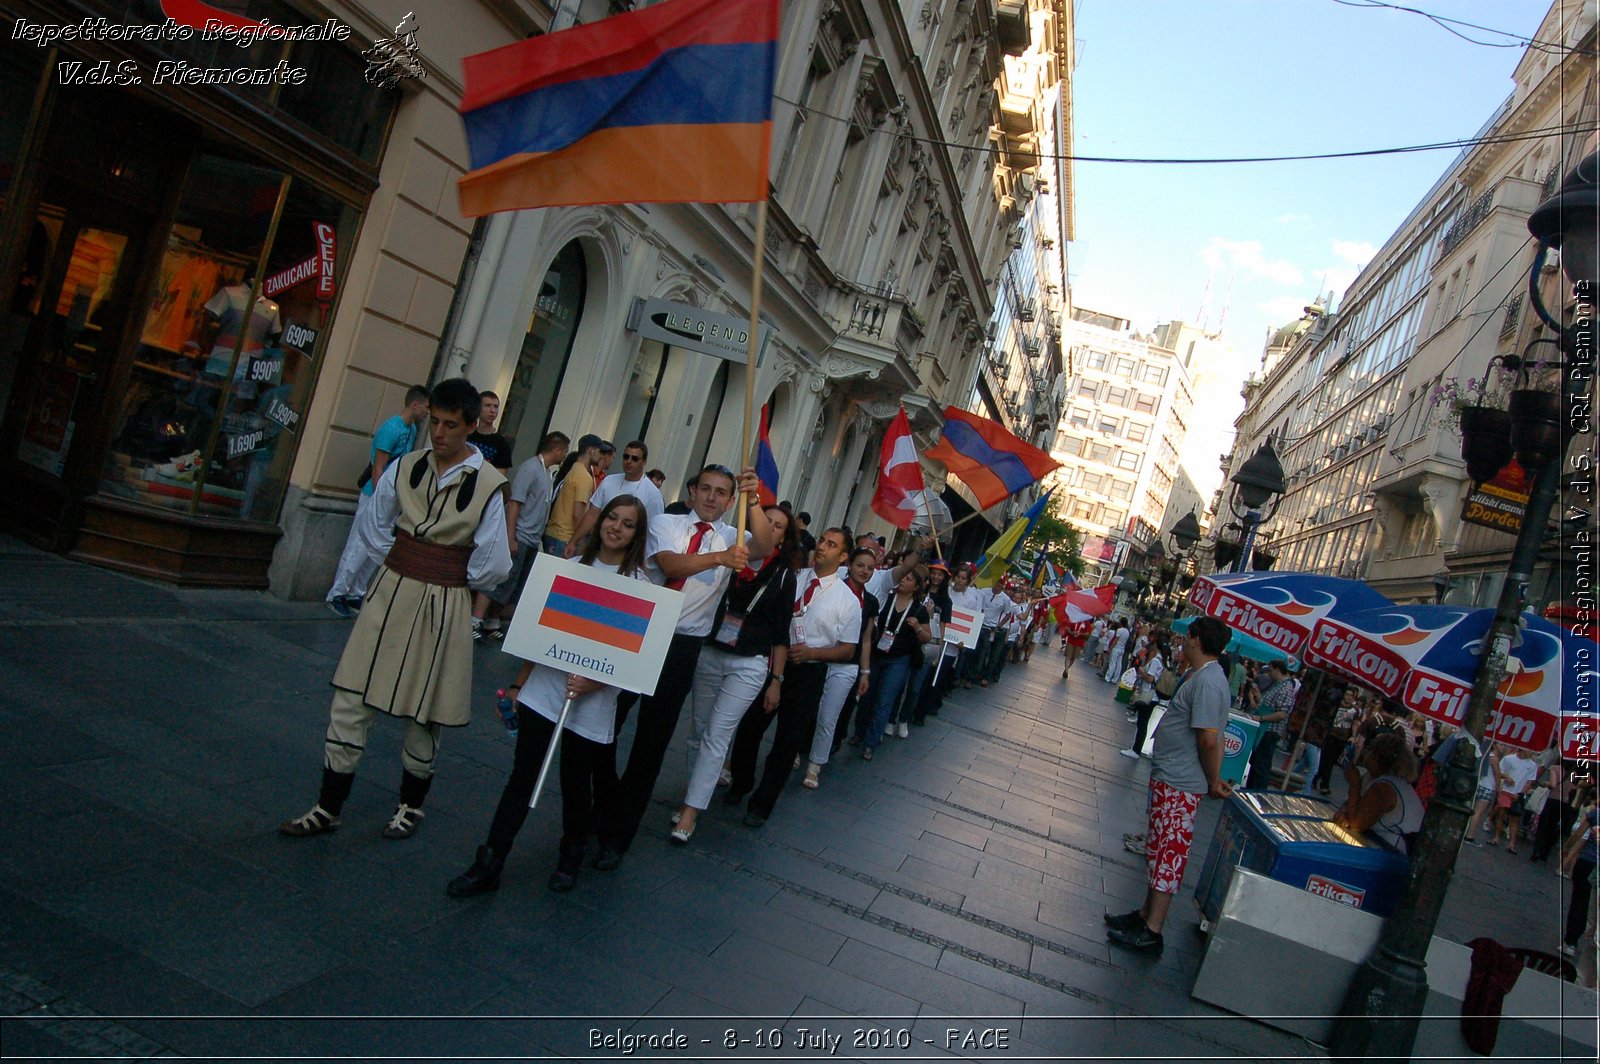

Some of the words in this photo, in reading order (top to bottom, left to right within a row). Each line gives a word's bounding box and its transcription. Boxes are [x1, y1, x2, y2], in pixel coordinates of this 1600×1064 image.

[318, 224, 334, 291] CENE
[267, 257, 318, 294] ZAKUCANE
[538, 295, 569, 321] EGEND
[669, 311, 750, 345] LEGEND
[1499, 500, 1526, 516] name
[1214, 595, 1300, 652] Frikom
[545, 642, 616, 676] Armenia
[1313, 623, 1400, 688] Frikom
